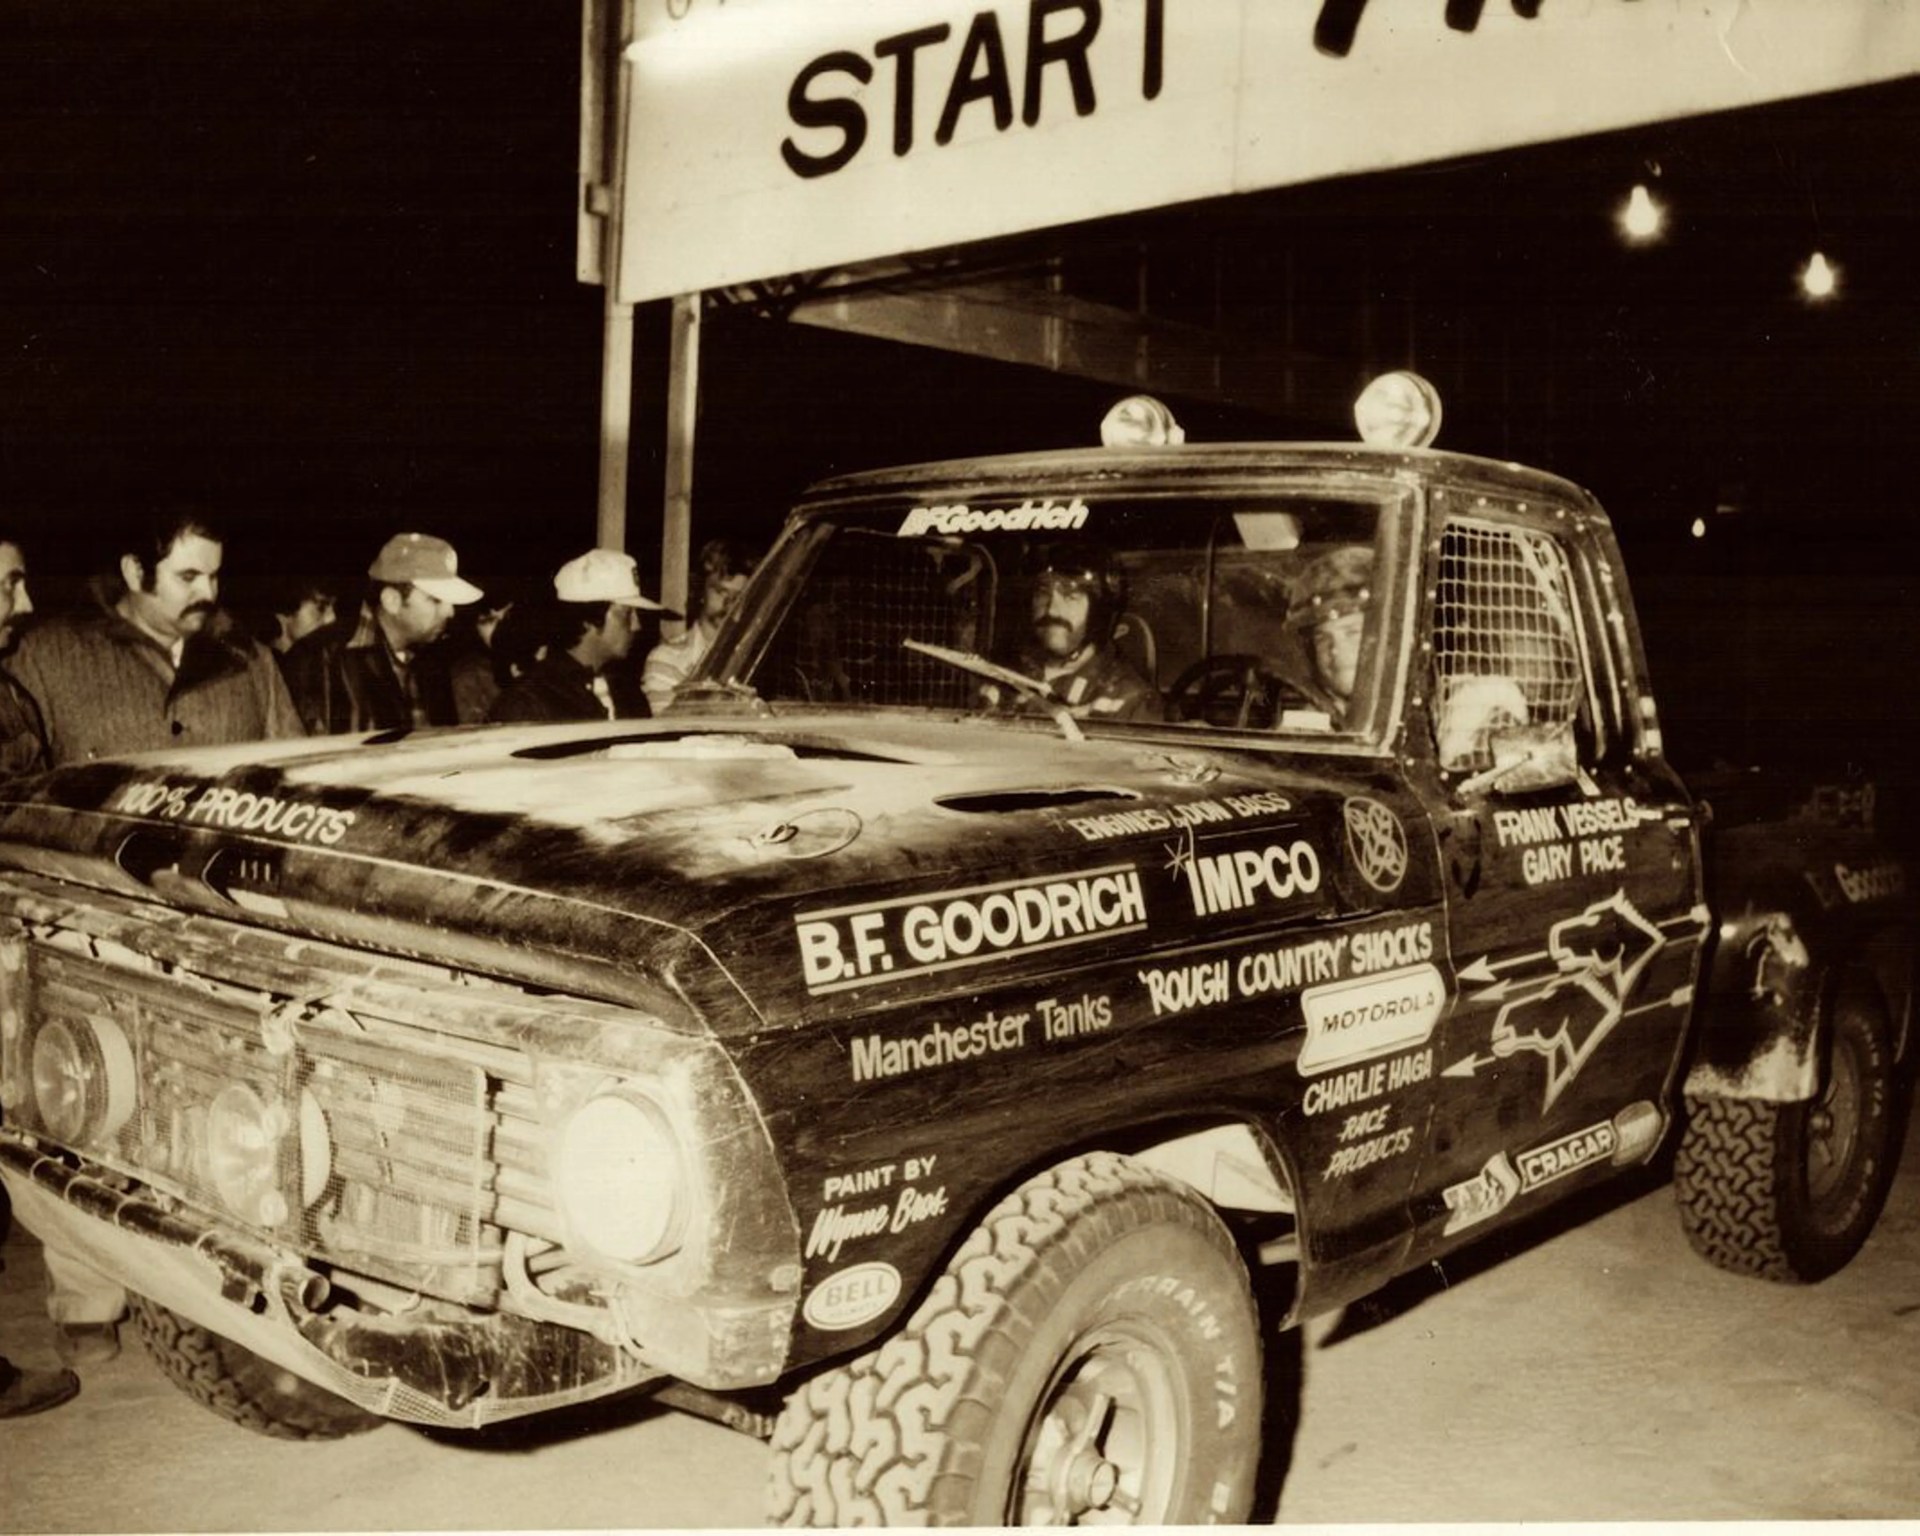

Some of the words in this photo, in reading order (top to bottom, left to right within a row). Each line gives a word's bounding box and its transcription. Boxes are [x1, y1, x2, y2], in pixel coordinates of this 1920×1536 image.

[117, 782, 198, 817] 100%
[187, 788, 355, 843] PRODUCTS
[1067, 808, 1171, 841] ENGINES
[1174, 799, 1233, 826] DON
[1222, 791, 1291, 818] BASS
[1493, 806, 1562, 847] FRANK
[1560, 797, 1640, 837] VESSELS
[1186, 840, 1321, 916] IMPCO
[1522, 844, 1573, 884] GARY
[1579, 835, 1626, 874] PACE
[797, 912, 893, 985] B.F.
[903, 872, 1147, 963] GOODRICH
[1351, 922, 1432, 974] SHOCKS
[851, 1011, 1030, 1082] Manchester
[1036, 994, 1112, 1041] Tanks
[1321, 991, 1436, 1034] MOTOROLA
[1303, 1063, 1387, 1116] CHARLIE
[1387, 1048, 1433, 1091] HAGA
[1337, 1104, 1391, 1143] RACE
[824, 1165, 896, 1201] PAINT
[904, 1155, 937, 1181] BY
[1322, 1125, 1414, 1182] PRODUCTS
[1525, 1127, 1614, 1184] CRAGAR
[826, 1273, 888, 1307] BELL
